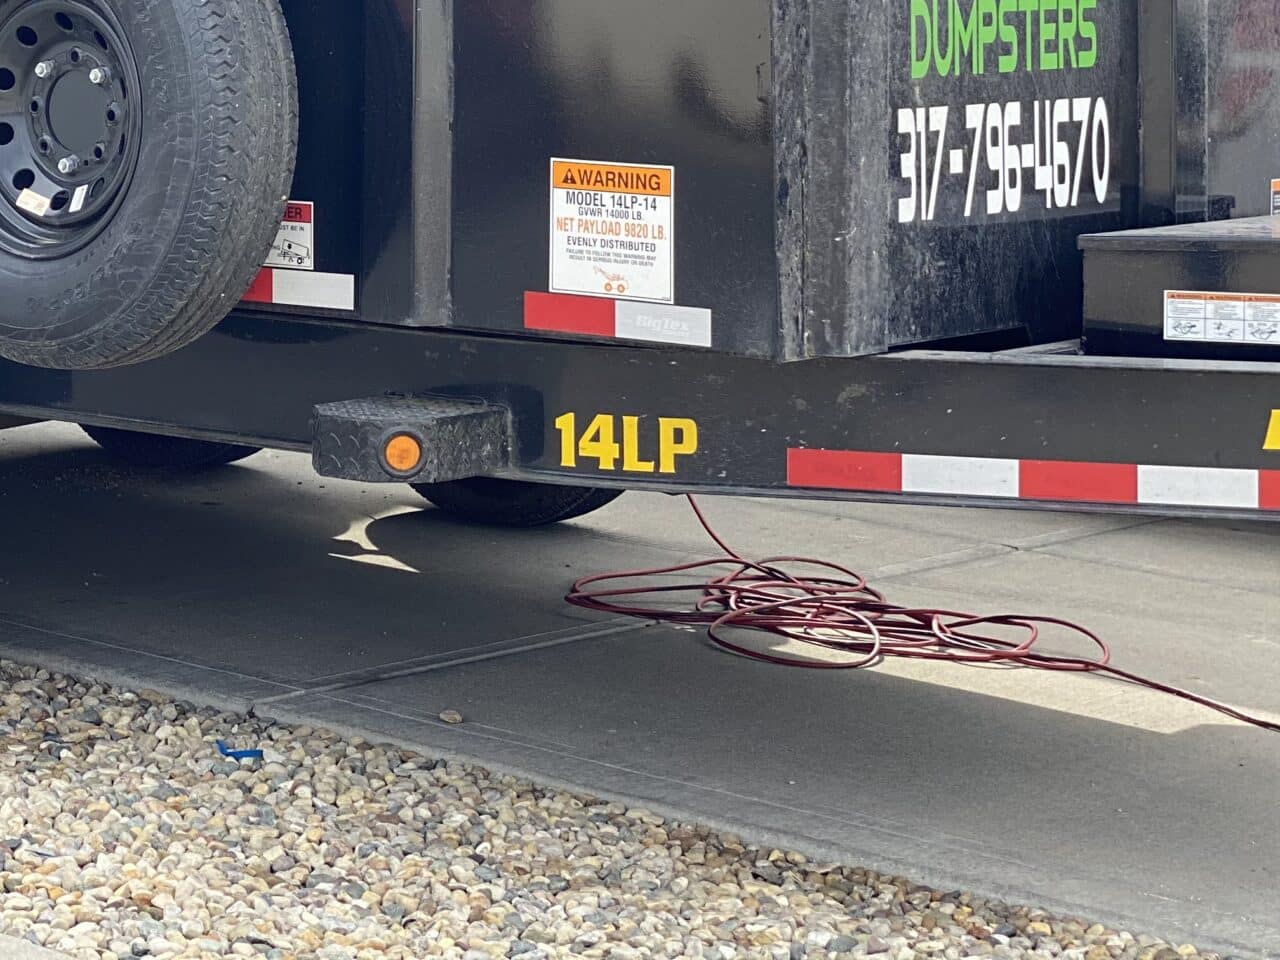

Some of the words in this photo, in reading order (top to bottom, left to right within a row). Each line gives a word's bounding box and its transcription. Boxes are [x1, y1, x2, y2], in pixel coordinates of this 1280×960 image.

[898, 96, 1110, 223] 317-796-4670
[578, 168, 661, 191] WARNING
[566, 191, 606, 207] MODEL
[610, 195, 657, 211] 14LP-14
[578, 206, 602, 217] GVWR
[605, 209, 629, 220] 14000
[556, 217, 575, 232] NET
[577, 219, 622, 236] PAYLOAD
[624, 222, 649, 239] 9820
[567, 236, 598, 248] EVENLY
[600, 239, 656, 253] DISTRIBUTED
[554, 411, 699, 475] 14LP
